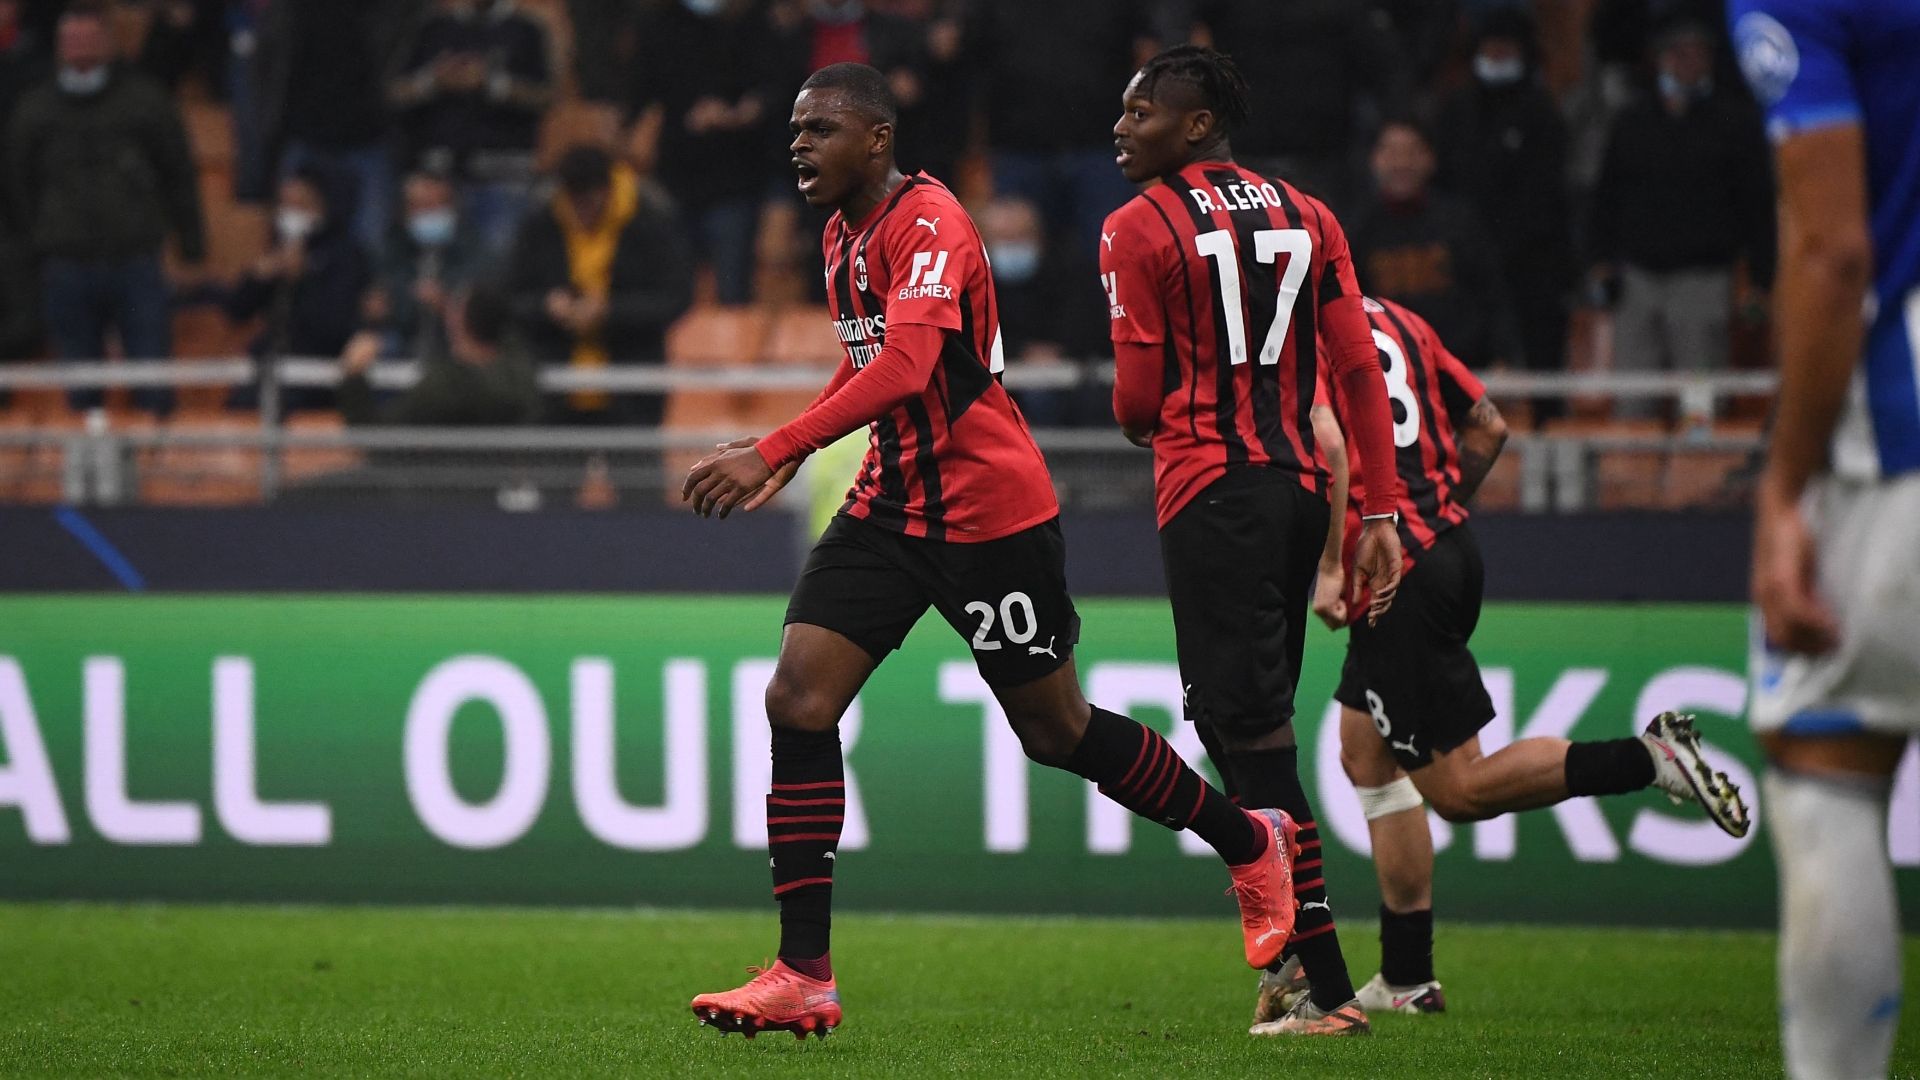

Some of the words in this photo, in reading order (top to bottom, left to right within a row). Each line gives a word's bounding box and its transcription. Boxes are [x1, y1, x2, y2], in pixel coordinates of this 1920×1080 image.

[898, 284, 953, 300] BitMEX
[1194, 228, 1313, 366] 17
[832, 312, 887, 342] mirates
[964, 591, 1038, 651] 20
[1365, 688, 1392, 738] 8
[404, 654, 869, 850] OUR
[937, 656, 1759, 866] TRKS
